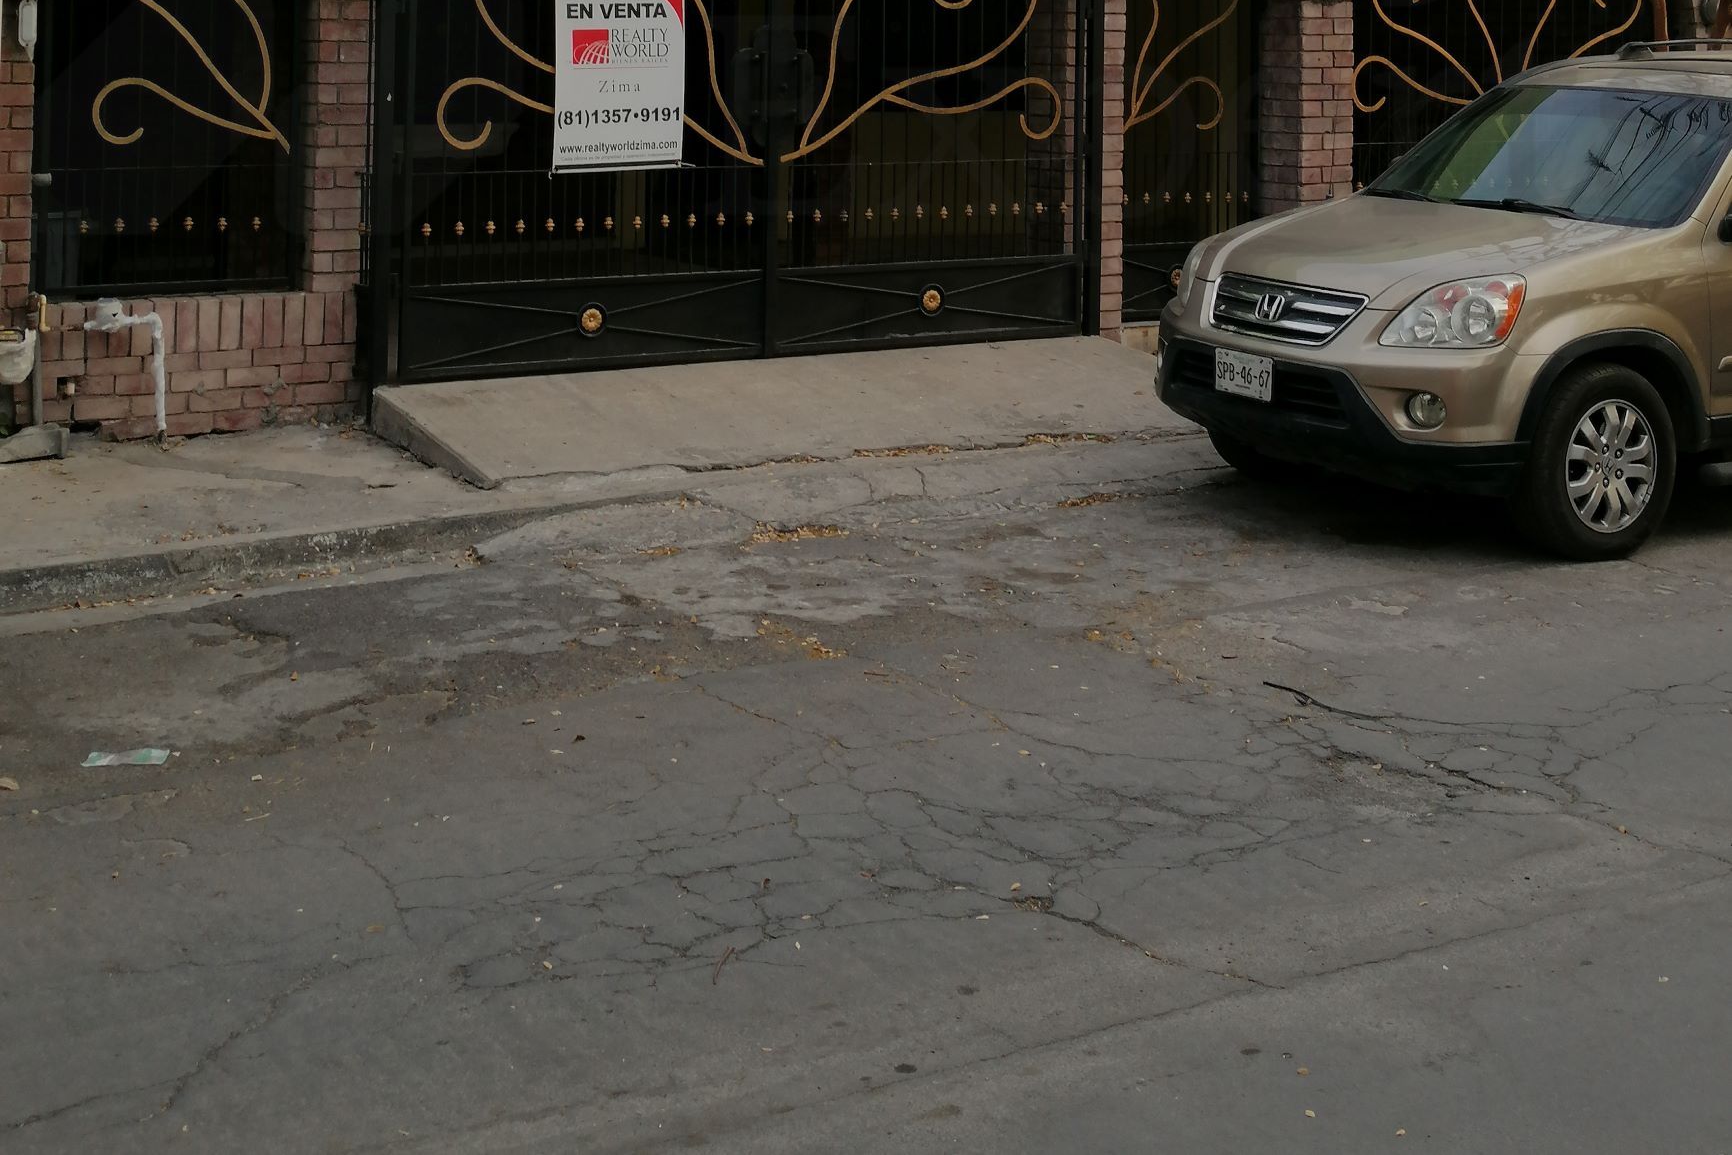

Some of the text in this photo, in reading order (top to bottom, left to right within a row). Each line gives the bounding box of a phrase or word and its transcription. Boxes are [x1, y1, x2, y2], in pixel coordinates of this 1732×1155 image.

[566, 3, 668, 19] EN VENTA
[611, 28, 668, 43] REALTY
[611, 43, 669, 58] WORLD
[598, 79, 641, 93] Zima
[559, 139, 678, 155] www.realtyworldzima.com
[1216, 360, 1271, 389] SPB-46-67
